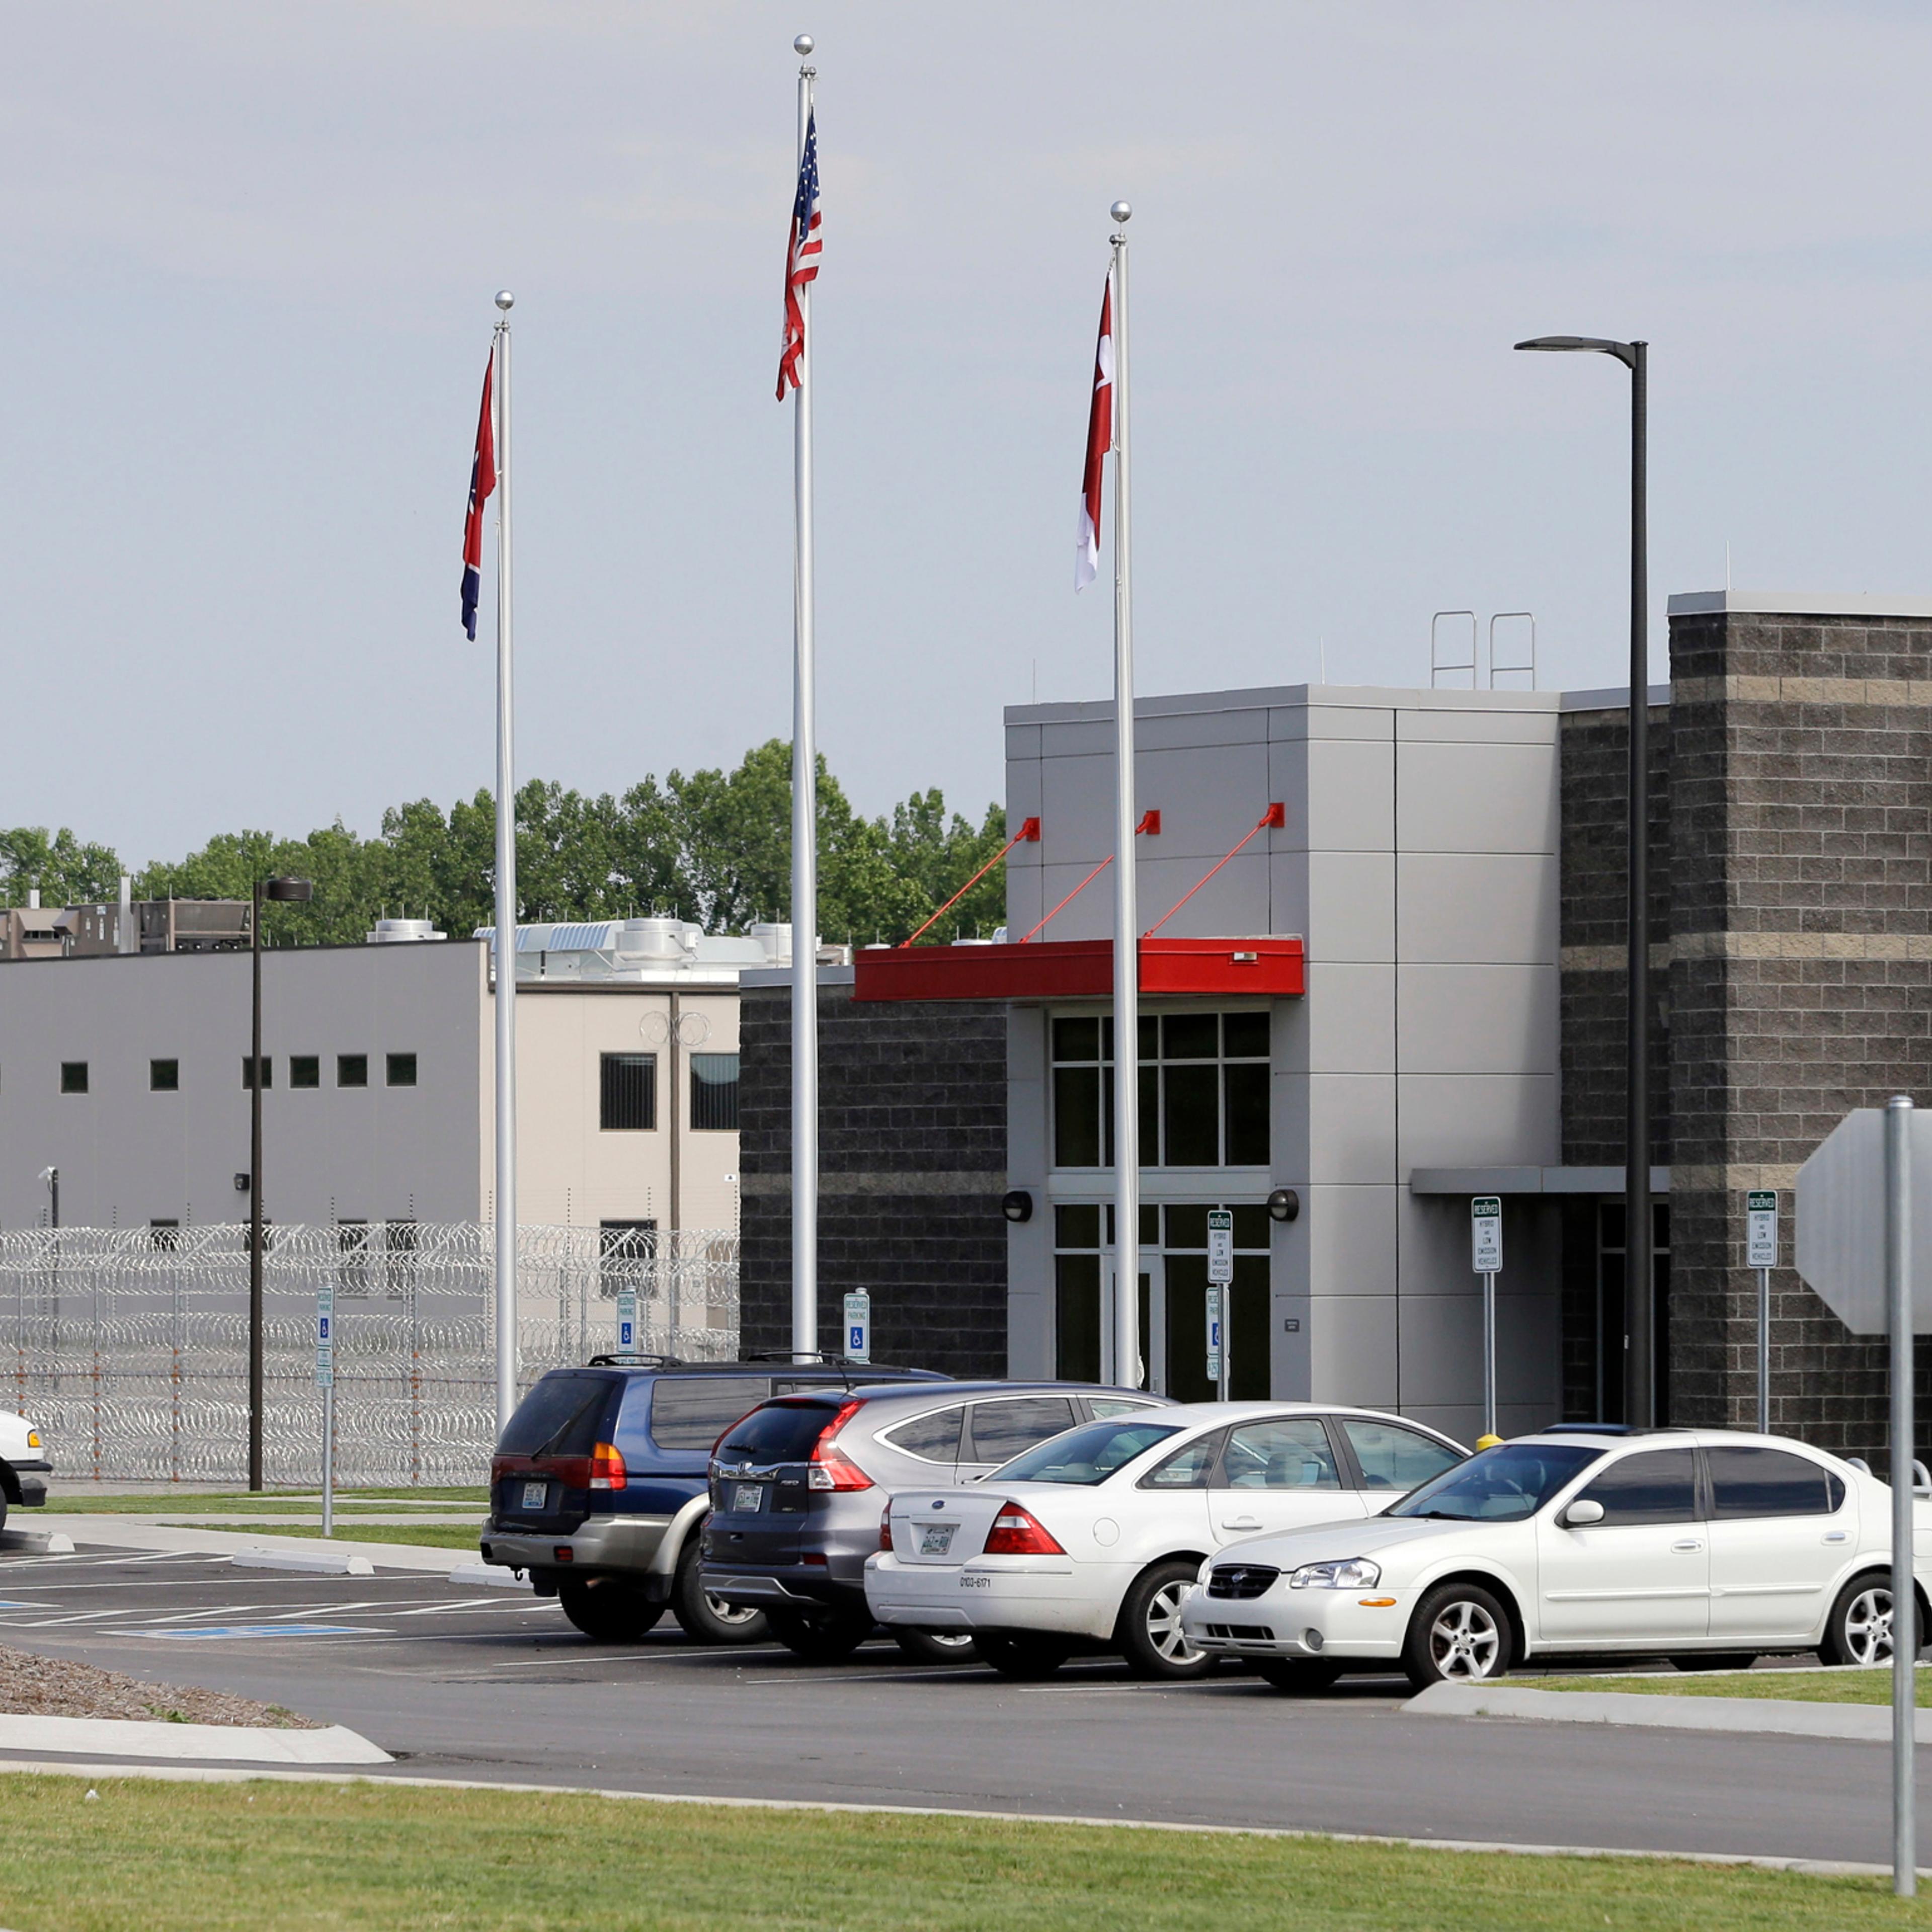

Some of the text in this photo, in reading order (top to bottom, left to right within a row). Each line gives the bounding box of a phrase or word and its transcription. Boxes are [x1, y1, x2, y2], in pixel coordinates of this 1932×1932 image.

[1749, 1198, 1774, 1208] RESERVED
[1474, 1204, 1498, 1214] RESERVED
[1210, 1218, 1230, 1227] RESERVED
[846, 1300, 867, 1309] RESERVED
[848, 1312, 866, 1320] PARKING
[959, 1576, 991, 1588] 0103-6171
